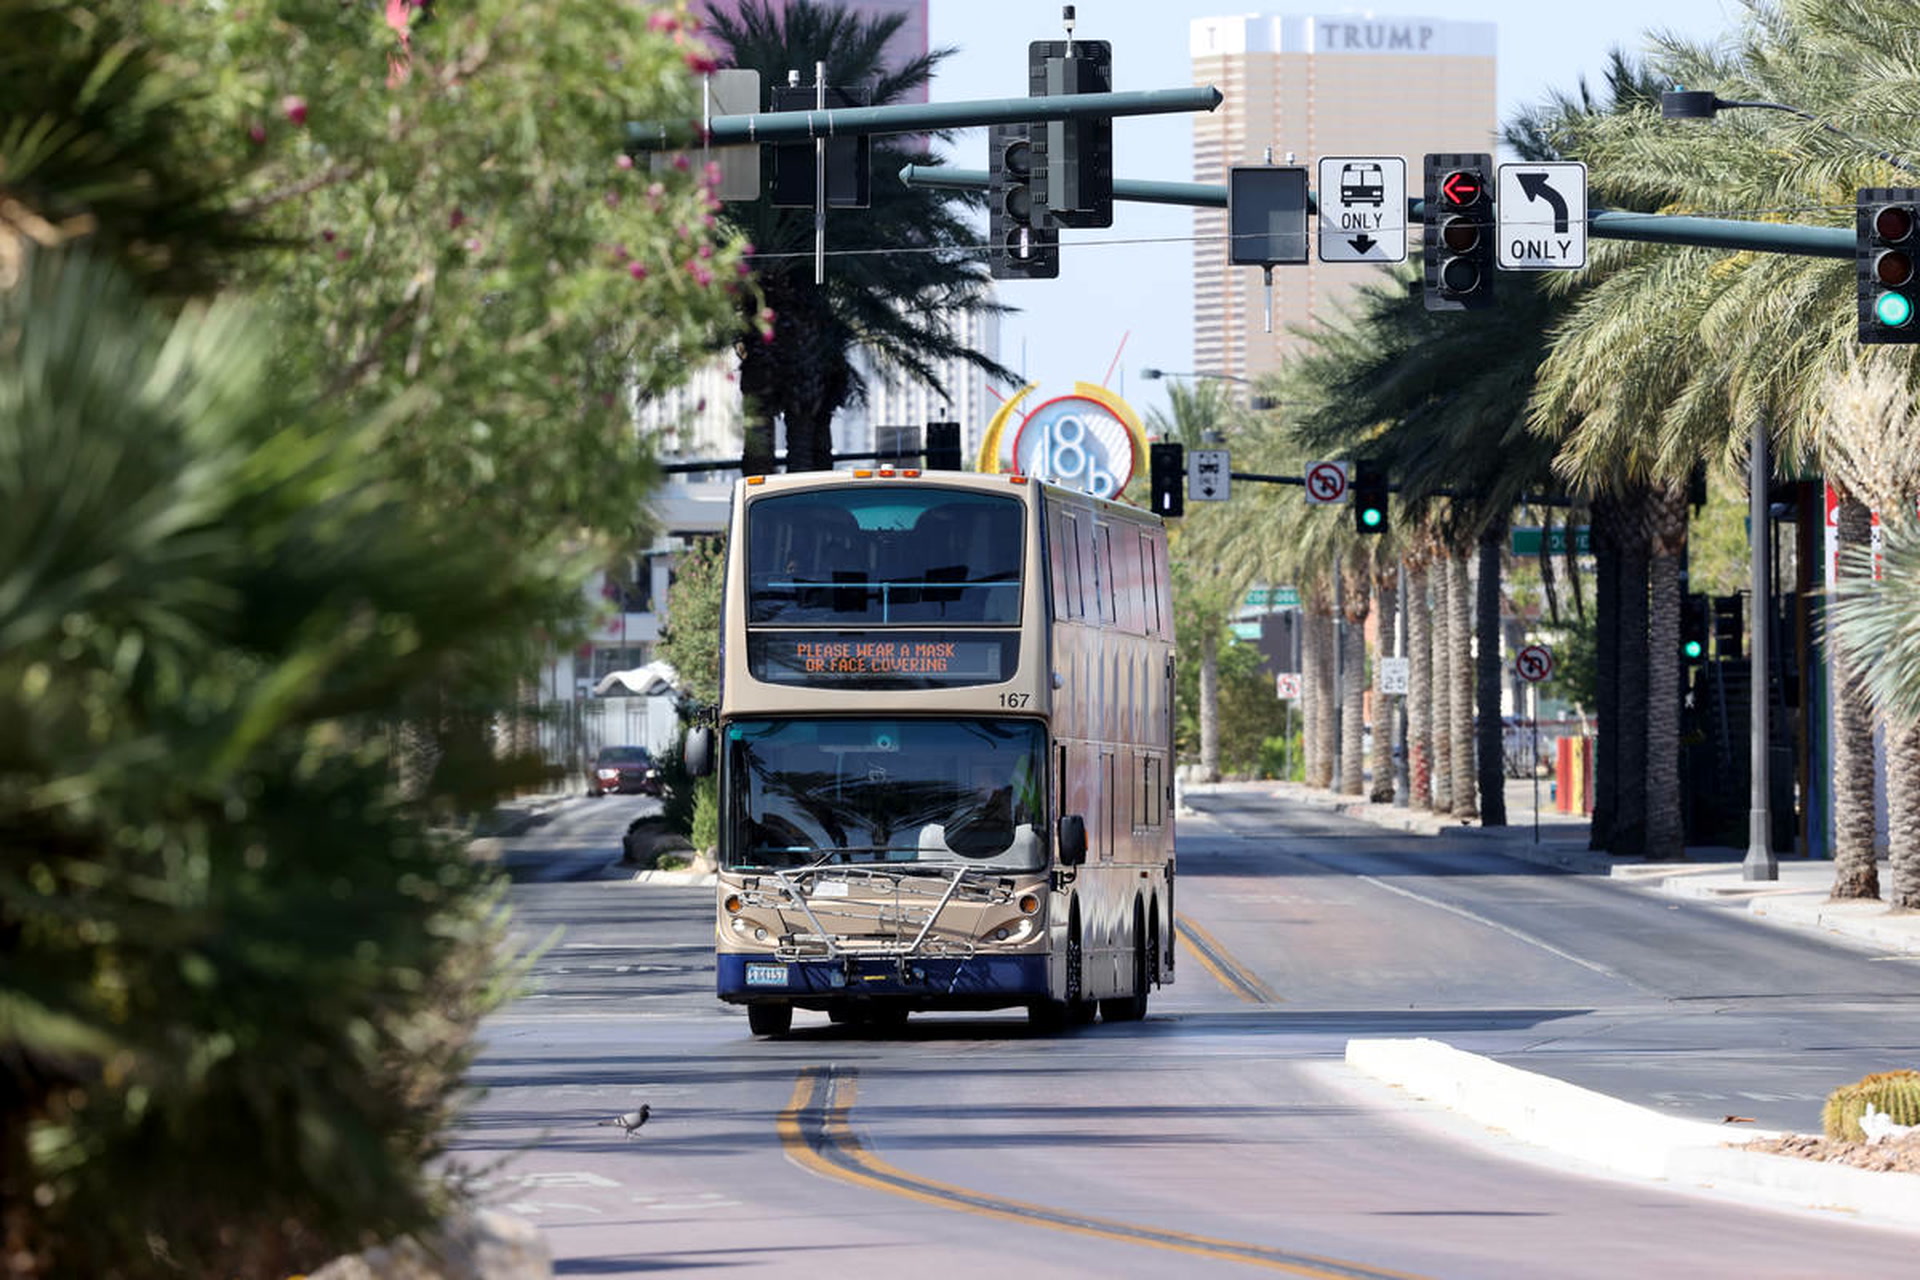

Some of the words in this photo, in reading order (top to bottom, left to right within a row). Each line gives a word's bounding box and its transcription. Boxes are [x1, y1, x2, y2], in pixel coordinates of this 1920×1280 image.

[1322, 24, 1434, 50] TRUMP
[1341, 213, 1383, 230] ONLY
[1511, 240, 1572, 259] ONLY
[797, 643, 850, 657] PLEASE
[856, 643, 895, 657] WEAR
[900, 643, 911, 657] A
[915, 643, 955, 657] MASK
[806, 659, 823, 672] OR
[829, 658, 865, 672] FACE
[871, 658, 947, 672] COVERING
[1385, 676, 1406, 689] 25
[999, 693, 1030, 708] 167
